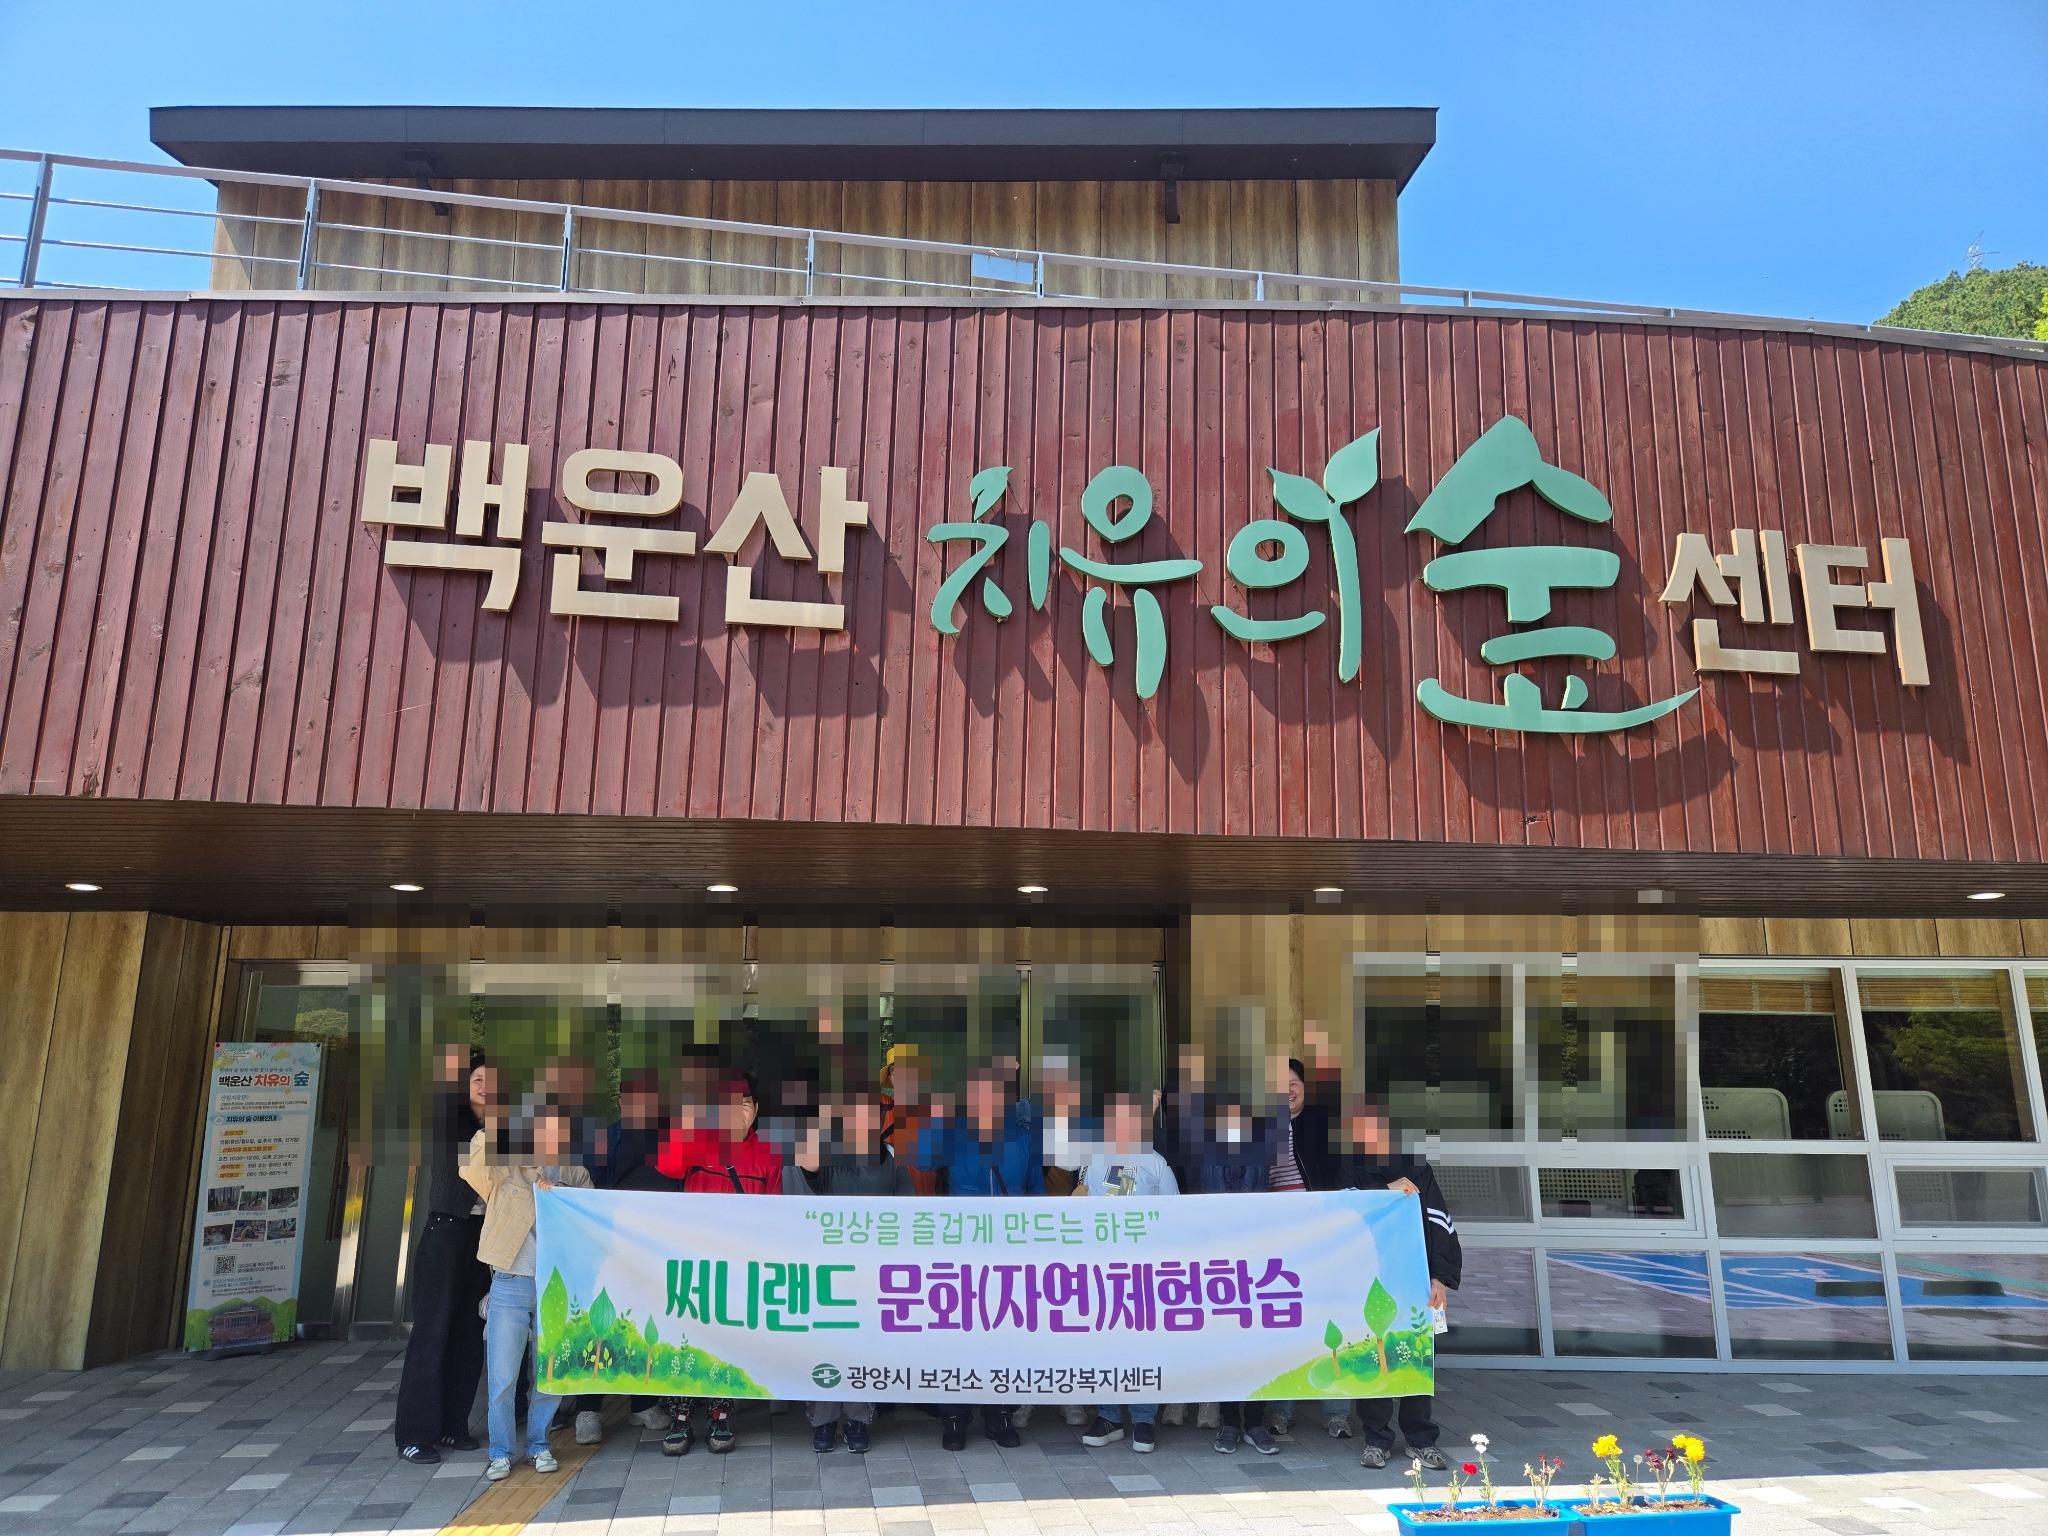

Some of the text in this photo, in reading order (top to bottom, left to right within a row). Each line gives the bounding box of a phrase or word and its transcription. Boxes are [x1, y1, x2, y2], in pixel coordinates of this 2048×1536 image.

[358, 414, 1931, 736] 백운산 치유의 숲 센터
[219, 1070, 309, 1087] 백운산 치유의 숲
[805, 1211, 1160, 1245] “일상을 즐겁게 만드는 하루”
[665, 1257, 1304, 1334] 써니랜드 문화(자연)체험학습
[846, 1366, 1163, 1394] 광양시 보건소 정신건강복지센터
